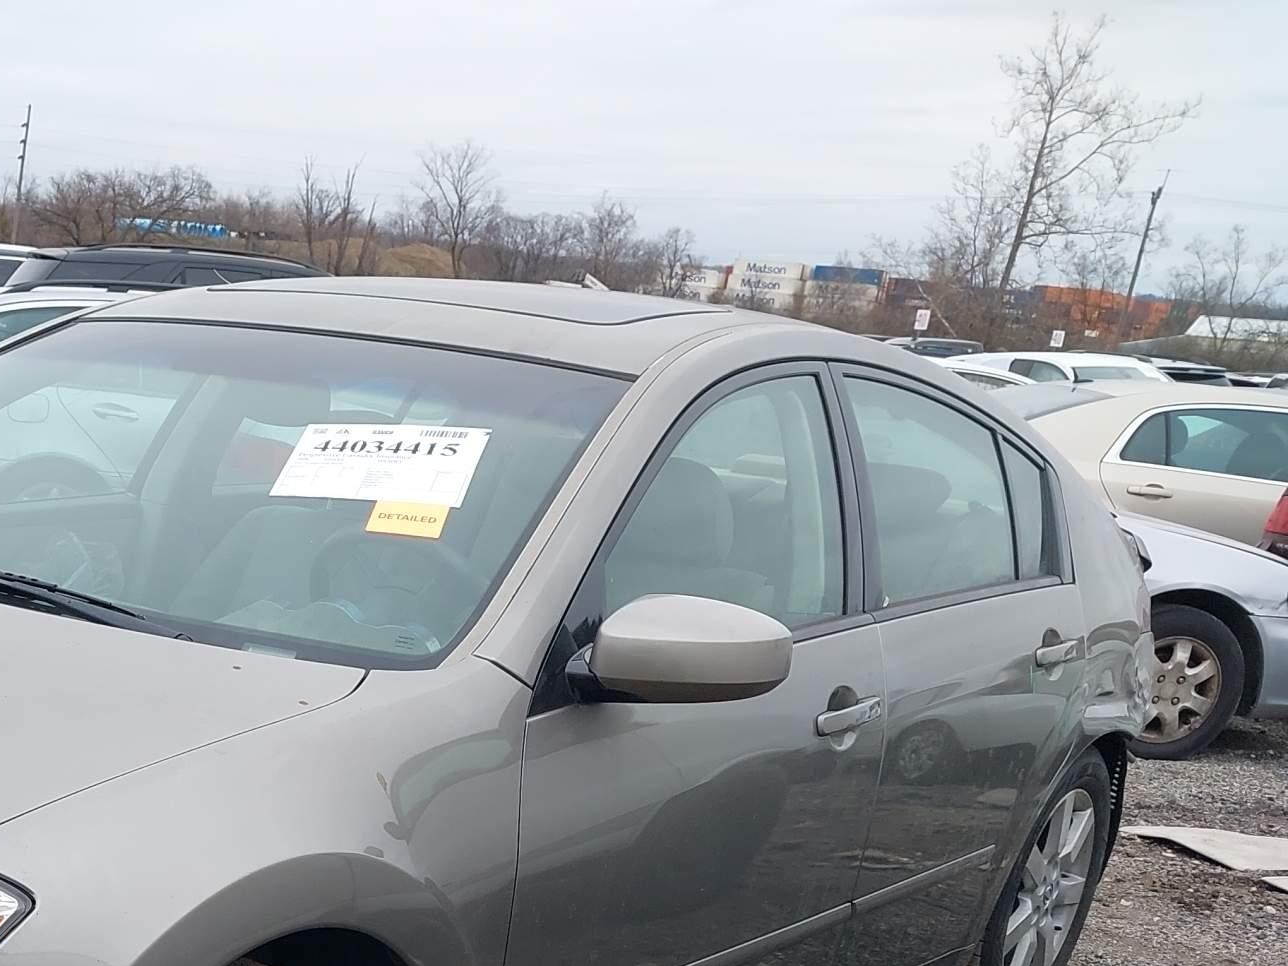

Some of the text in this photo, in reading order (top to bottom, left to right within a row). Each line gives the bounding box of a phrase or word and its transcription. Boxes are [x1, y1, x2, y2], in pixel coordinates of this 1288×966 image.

[746, 262, 786, 274] Matson
[741, 278, 781, 290] Matson
[313, 440, 461, 457] 44034415
[377, 512, 438, 525] DETAILED
